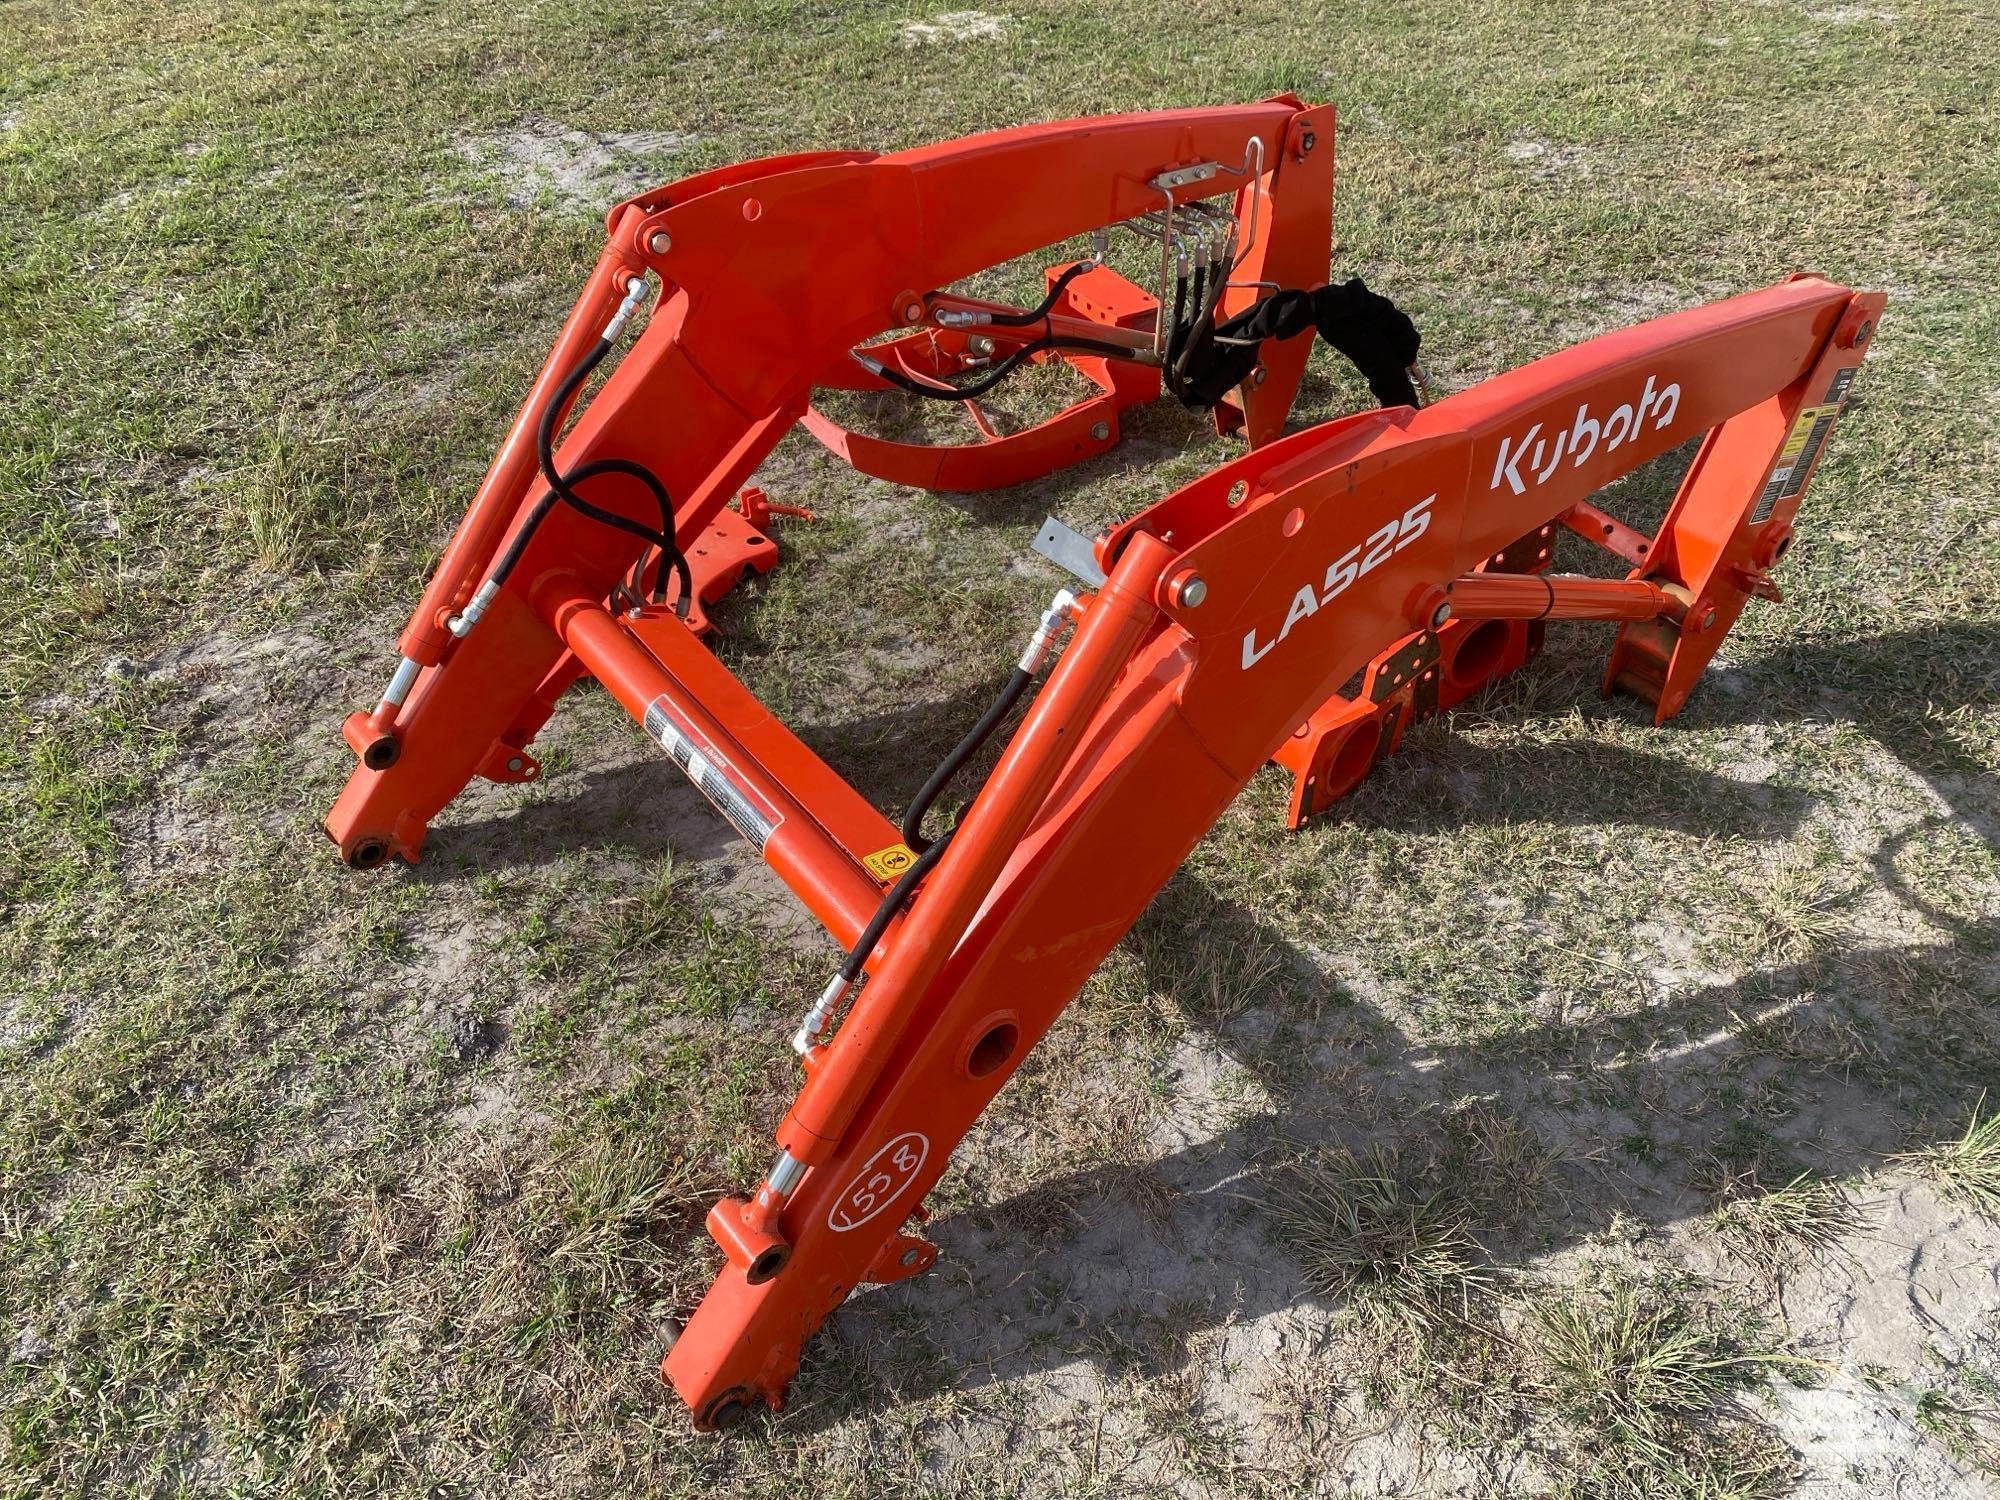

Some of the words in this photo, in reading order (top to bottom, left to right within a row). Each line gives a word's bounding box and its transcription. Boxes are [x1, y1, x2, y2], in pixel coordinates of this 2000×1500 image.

[1490, 375, 1681, 496] Kubota
[1241, 493, 1437, 671] LA525
[707, 749, 727, 769] DANGER
[839, 1144, 919, 1226] 1558
